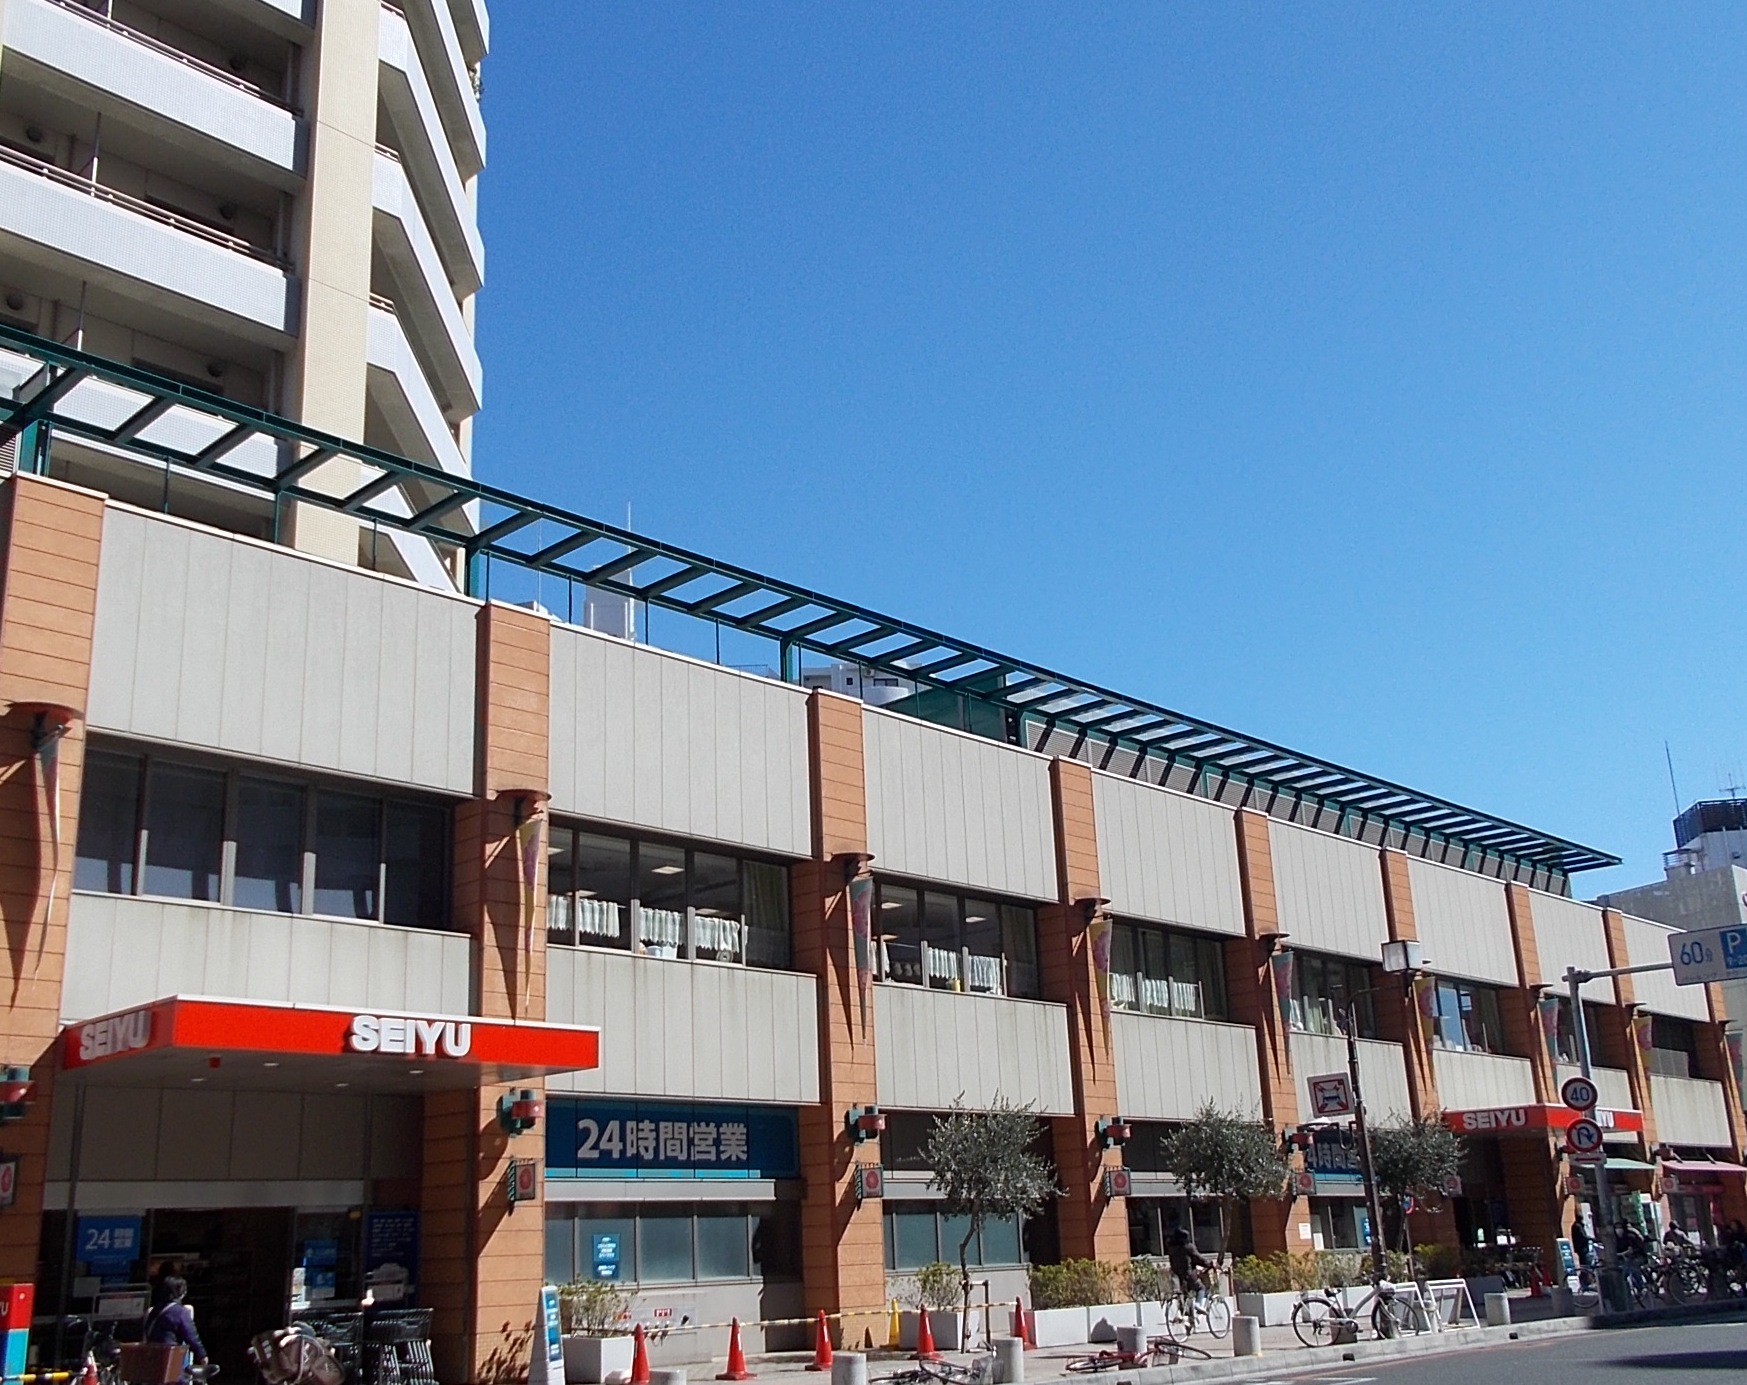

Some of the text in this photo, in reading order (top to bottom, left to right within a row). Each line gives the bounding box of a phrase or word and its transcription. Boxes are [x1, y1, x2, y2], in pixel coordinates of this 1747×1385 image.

[1726, 932, 1741, 954] P
[79, 1009, 151, 1060] SEIYU
[350, 1014, 472, 1057] SEIYU
[1570, 1087, 1590, 1101] 40
[1462, 1108, 1526, 1130] SEIYU
[577, 1118, 748, 1161] 24時間営業
